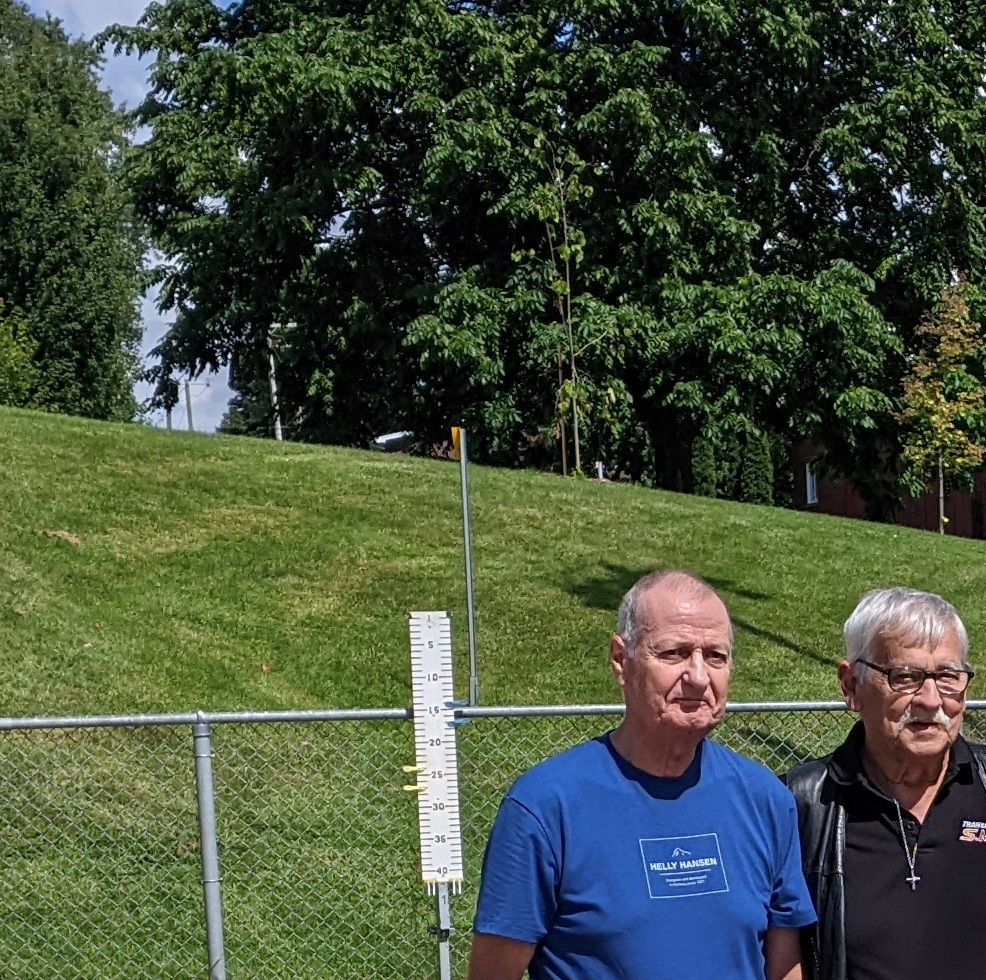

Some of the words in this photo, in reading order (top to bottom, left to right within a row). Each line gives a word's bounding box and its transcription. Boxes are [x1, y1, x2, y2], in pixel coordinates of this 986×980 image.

[427, 640, 434, 649] 5
[427, 673, 438, 682] 10
[428, 706, 440, 715] 15
[429, 738, 442, 747] 20
[431, 771, 443, 779] 25
[432, 802, 446, 811] 30
[434, 834, 447, 844] 35
[649, 861, 678, 871] HELLY
[679, 857, 718, 869] HANSEN
[436, 866, 448, 875] 40
